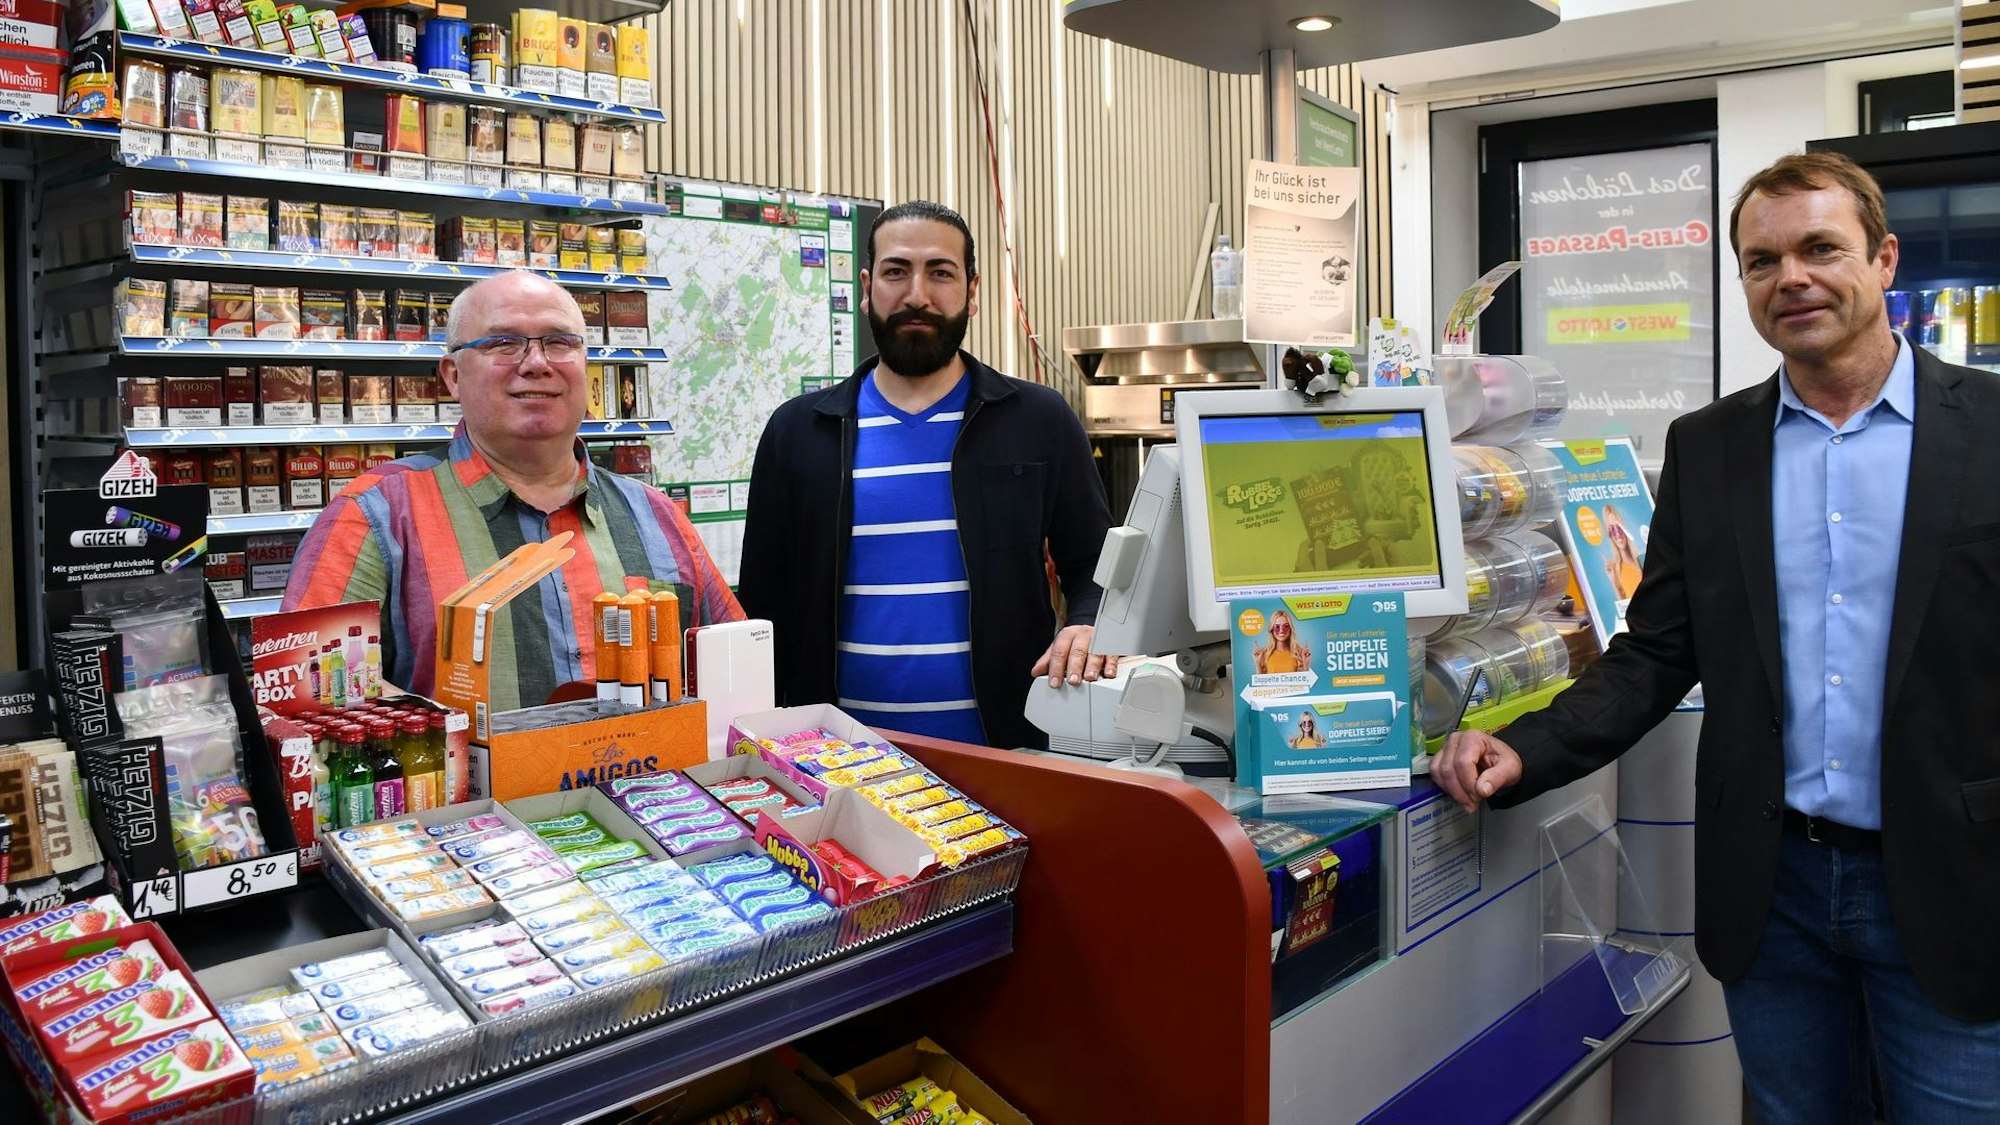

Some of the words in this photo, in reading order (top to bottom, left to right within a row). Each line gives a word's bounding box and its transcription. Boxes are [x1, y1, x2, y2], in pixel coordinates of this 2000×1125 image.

[523, 38, 556, 51] BRIGG
[0, 68, 42, 87] Winston
[1255, 168, 1269, 183] Ihr
[1272, 171, 1304, 187] Glück
[1308, 175, 1326, 187] ist
[1254, 185, 1270, 199] bei
[1274, 191, 1294, 202] uns
[1298, 191, 1340, 204] sicher
[172, 382, 215, 392] MOODS
[102, 478, 154, 496] GIZEH
[292, 480, 320, 488] Rauchen
[1609, 483, 1640, 499] SIEBEN
[82, 531, 127, 546] GIZEH
[68, 562, 112, 574] gereinigter
[113, 558, 154, 569] Aktivkohle
[67, 574, 82, 582] aus
[83, 569, 155, 581] Kokosnussschalen
[1384, 601, 1397, 610] DS
[1326, 631, 1339, 639] Die
[1326, 639, 1388, 654] DOPPELTE
[1326, 652, 1389, 672] SIEBEN
[168, 670, 200, 684] ACTIVE
[1254, 675, 1279, 684] Doppelte
[1280, 674, 1309, 683] Chance,
[71, 645, 110, 738] GIZEH
[257, 685, 296, 703] BOX
[1278, 713, 1289, 721] DS
[1328, 728, 1364, 739] DOPPELTE
[1368, 754, 1398, 763] gewinnen!
[559, 756, 659, 792] AMIGOS
[120, 746, 158, 847] GIZEH
[767, 835, 809, 872] Hubba
[286, 862, 296, 876] €
[19, 948, 124, 999] mentos
[38, 987, 72, 1010] fruit
[44, 979, 154, 1037] mentos
[67, 1020, 102, 1045] fruit
[104, 1001, 144, 1046] 3
[78, 1029, 192, 1091] mentos
[102, 1073, 138, 1099] fruit
[140, 1053, 181, 1101] 3
[128, 1099, 184, 1121] mentos
